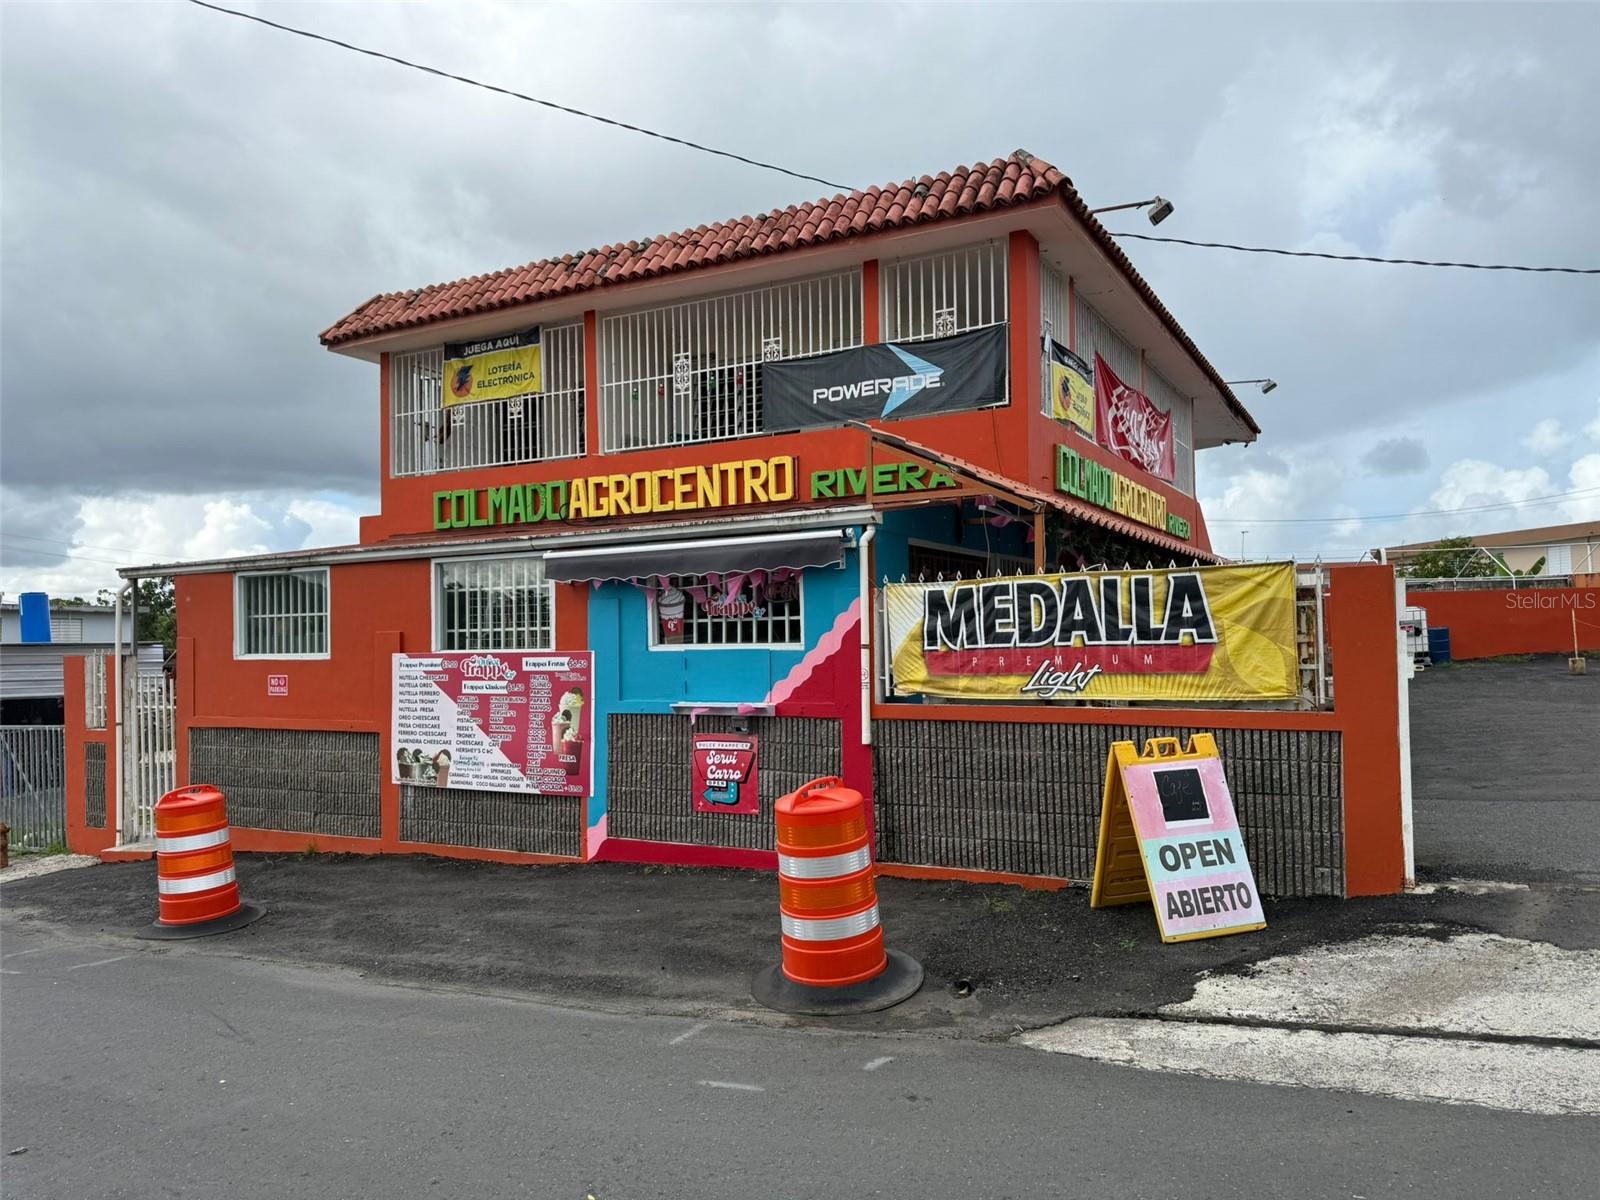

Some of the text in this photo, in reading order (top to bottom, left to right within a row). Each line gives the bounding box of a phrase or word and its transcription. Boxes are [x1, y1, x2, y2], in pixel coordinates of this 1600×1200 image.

[464, 341, 494, 356] JUEGA
[488, 360, 522, 376] LOTERÍA
[476, 372, 535, 389] ELECTRÓNICA
[812, 373, 941, 404] POWERADE
[432, 455, 956, 530] COLMADO AGROCENTRO RIVERA
[1056, 444, 1191, 541] COLMADO AGROCENTRO RIVERA
[923, 571, 1218, 651] MEDALLA
[460, 658, 509, 680] Frappe
[1021, 658, 1103, 698] Light
[530, 704, 552, 712] MANGO
[528, 728, 546, 736] COCO
[560, 754, 576, 762] FRESA
[706, 750, 738, 764] Servi
[526, 767, 566, 776] FRESA GUINEO
[706, 765, 742, 780] Carro
[540, 784, 564, 792] COLADA
[543, 776, 566, 784] COLADA
[1158, 838, 1236, 872] OPEN
[1166, 882, 1253, 920] ABIERTO
